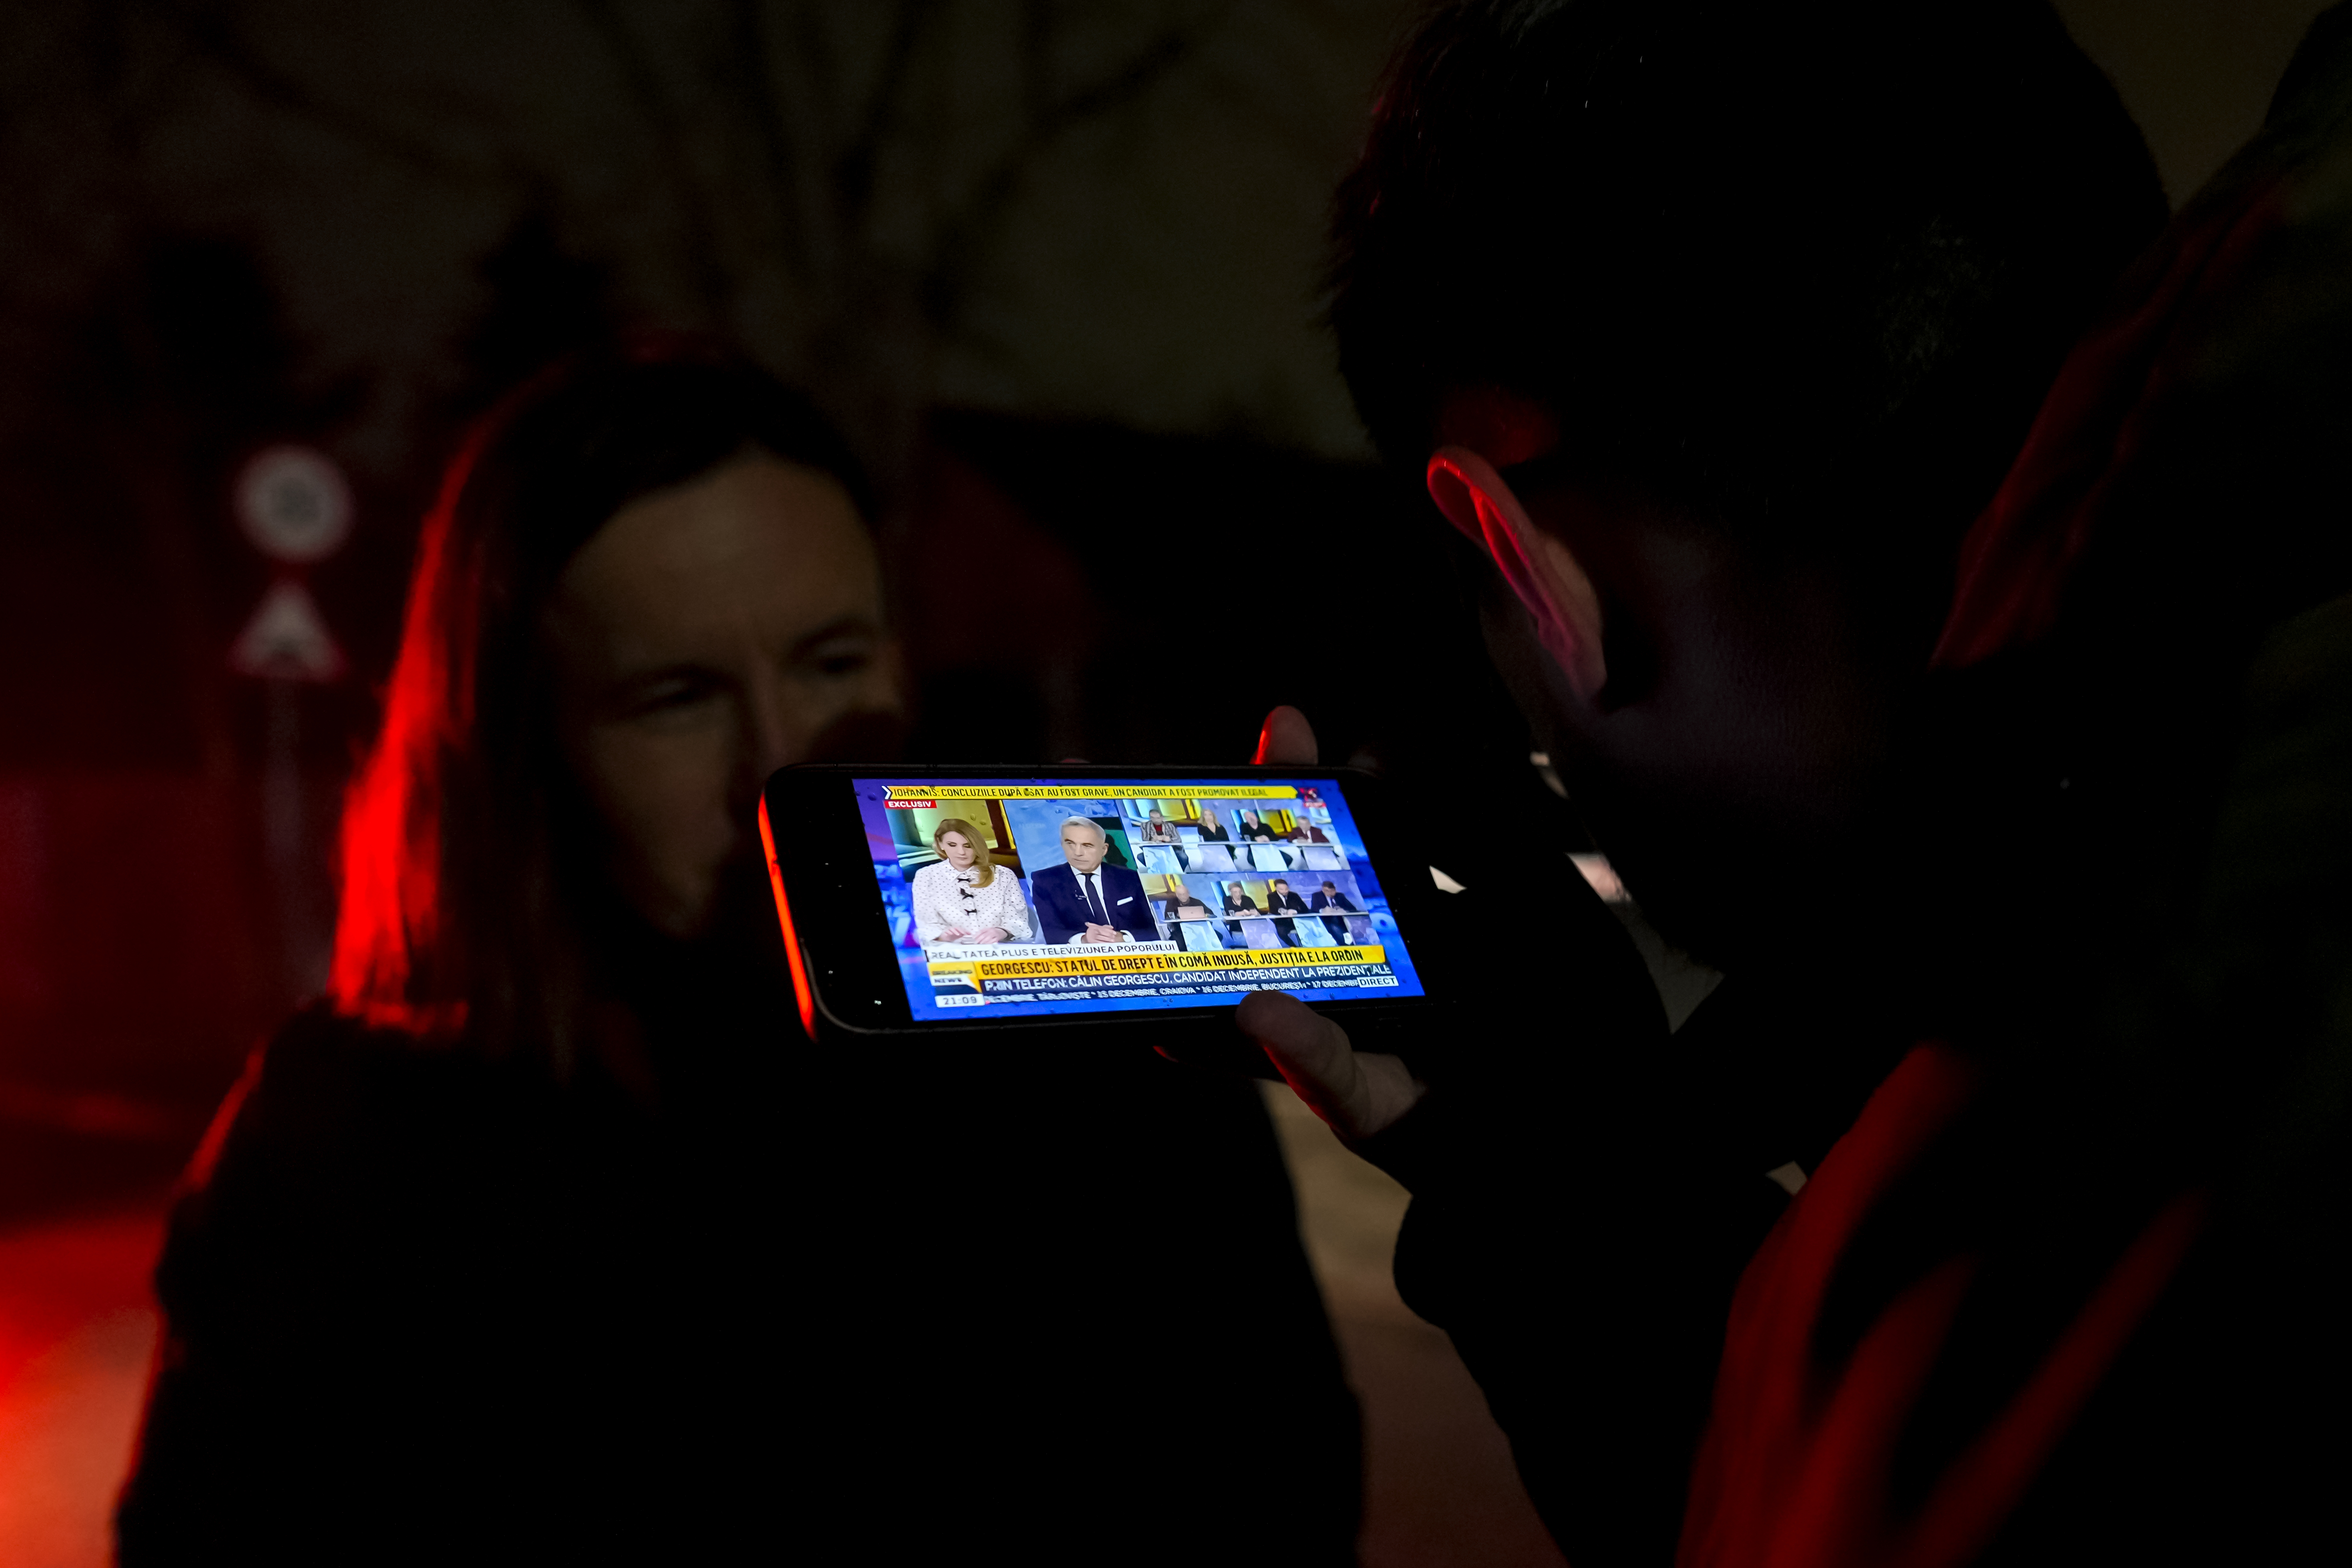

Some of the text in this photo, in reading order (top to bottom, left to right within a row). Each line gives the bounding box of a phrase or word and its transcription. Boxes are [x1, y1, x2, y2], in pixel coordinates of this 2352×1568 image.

[894, 788, 940, 796] IOHANNIS:
[941, 788, 997, 797] CONCLUZIILE
[998, 787, 1022, 797] DUPĂ
[1048, 788, 1059, 796] AU
[1061, 788, 1081, 796] FOST
[1083, 788, 1113, 797] GRAVE,
[1114, 788, 1125, 796] UN
[1127, 788, 1167, 796] CANDIDAT
[1169, 788, 1175, 796] A
[1176, 788, 1196, 796] FOST
[1197, 788, 1239, 796] PROMOVAT
[1040, 946, 1115, 956] TELEVIZIUNEA
[1117, 943, 1175, 952] POPORULUI
[982, 949, 1364, 975] GEORGESCU: STATUL DE DREPT E ÎN COMĂ INDUSĂ, JUSTIȚIA E LA ORDIN
[1013, 977, 1068, 990] TELEFON:
[1069, 974, 1102, 988] CĂLIN
[1104, 973, 1173, 986] GEORGESCU,
[1173, 970, 1225, 982] CANDIDAT
[1229, 968, 1299, 980] INDEPENDENT
[1302, 968, 1316, 977] LA
[1361, 978, 1396, 986] DIRECT
